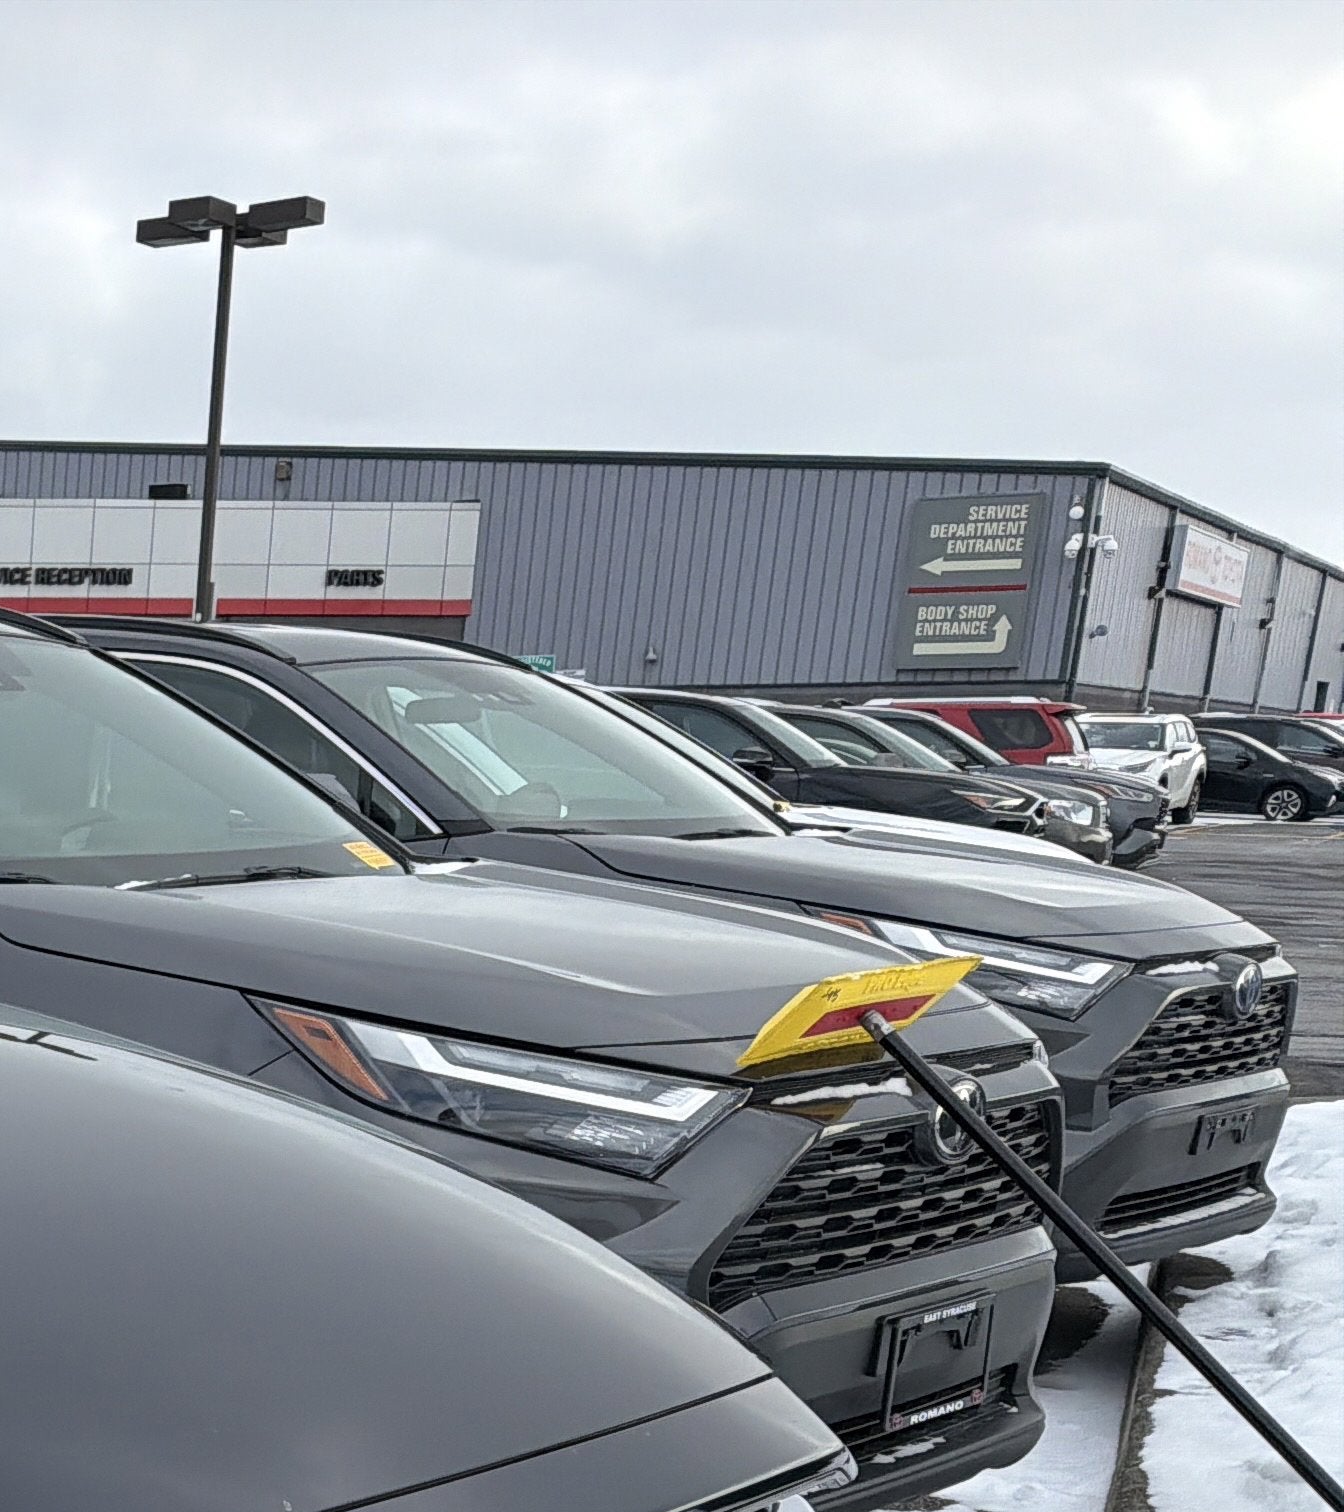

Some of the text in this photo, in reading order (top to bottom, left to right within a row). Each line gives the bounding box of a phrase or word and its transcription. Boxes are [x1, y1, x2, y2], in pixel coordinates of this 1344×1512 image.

[968, 504, 1030, 520] SERVICE
[930, 521, 1028, 538] DEPARTMENT
[947, 538, 1025, 554] ENTRANCE
[34, 567, 134, 586] RECEPTION
[326, 569, 385, 587] PARTS
[917, 604, 997, 621] BODY SHOP
[915, 621, 988, 637] ENTRANCE
[923, 1311, 942, 1324] EAST
[910, 1399, 964, 1425] ROMANO
